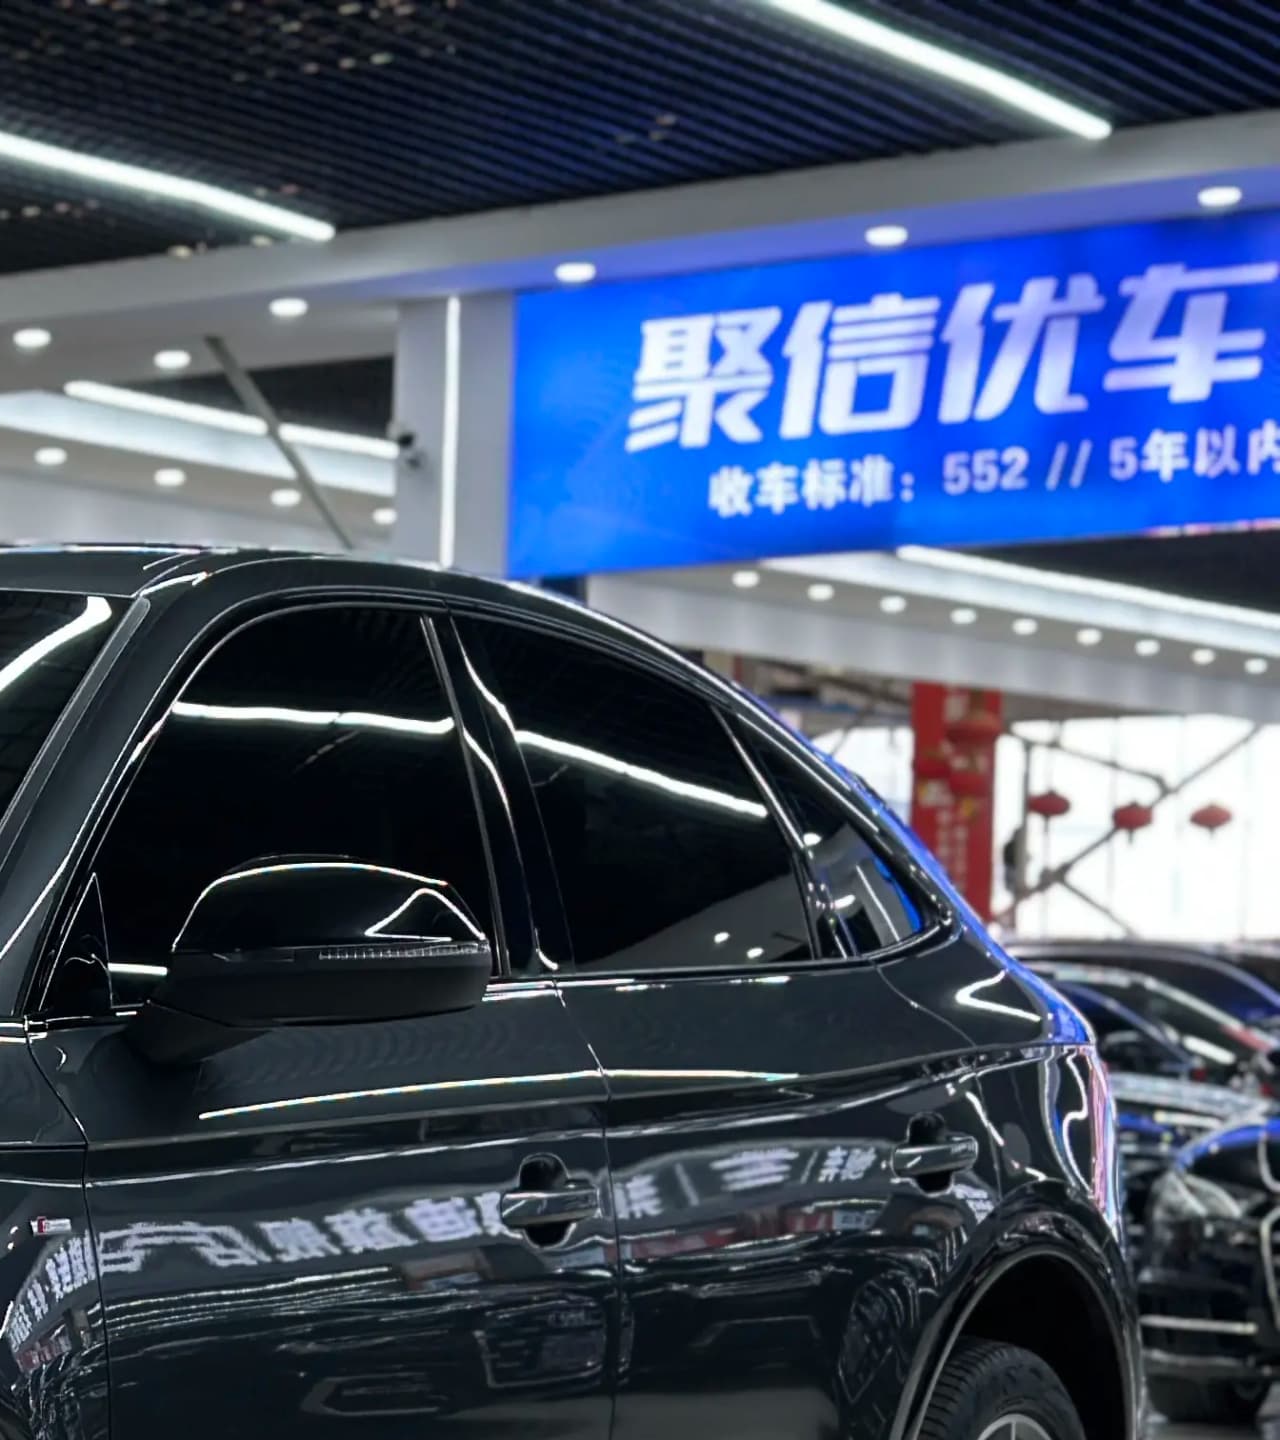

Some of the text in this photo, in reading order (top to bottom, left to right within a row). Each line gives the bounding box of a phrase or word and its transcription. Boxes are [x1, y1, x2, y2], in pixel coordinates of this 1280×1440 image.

[625, 262, 1279, 453] 聚信优车
[943, 446, 1029, 495] 552
